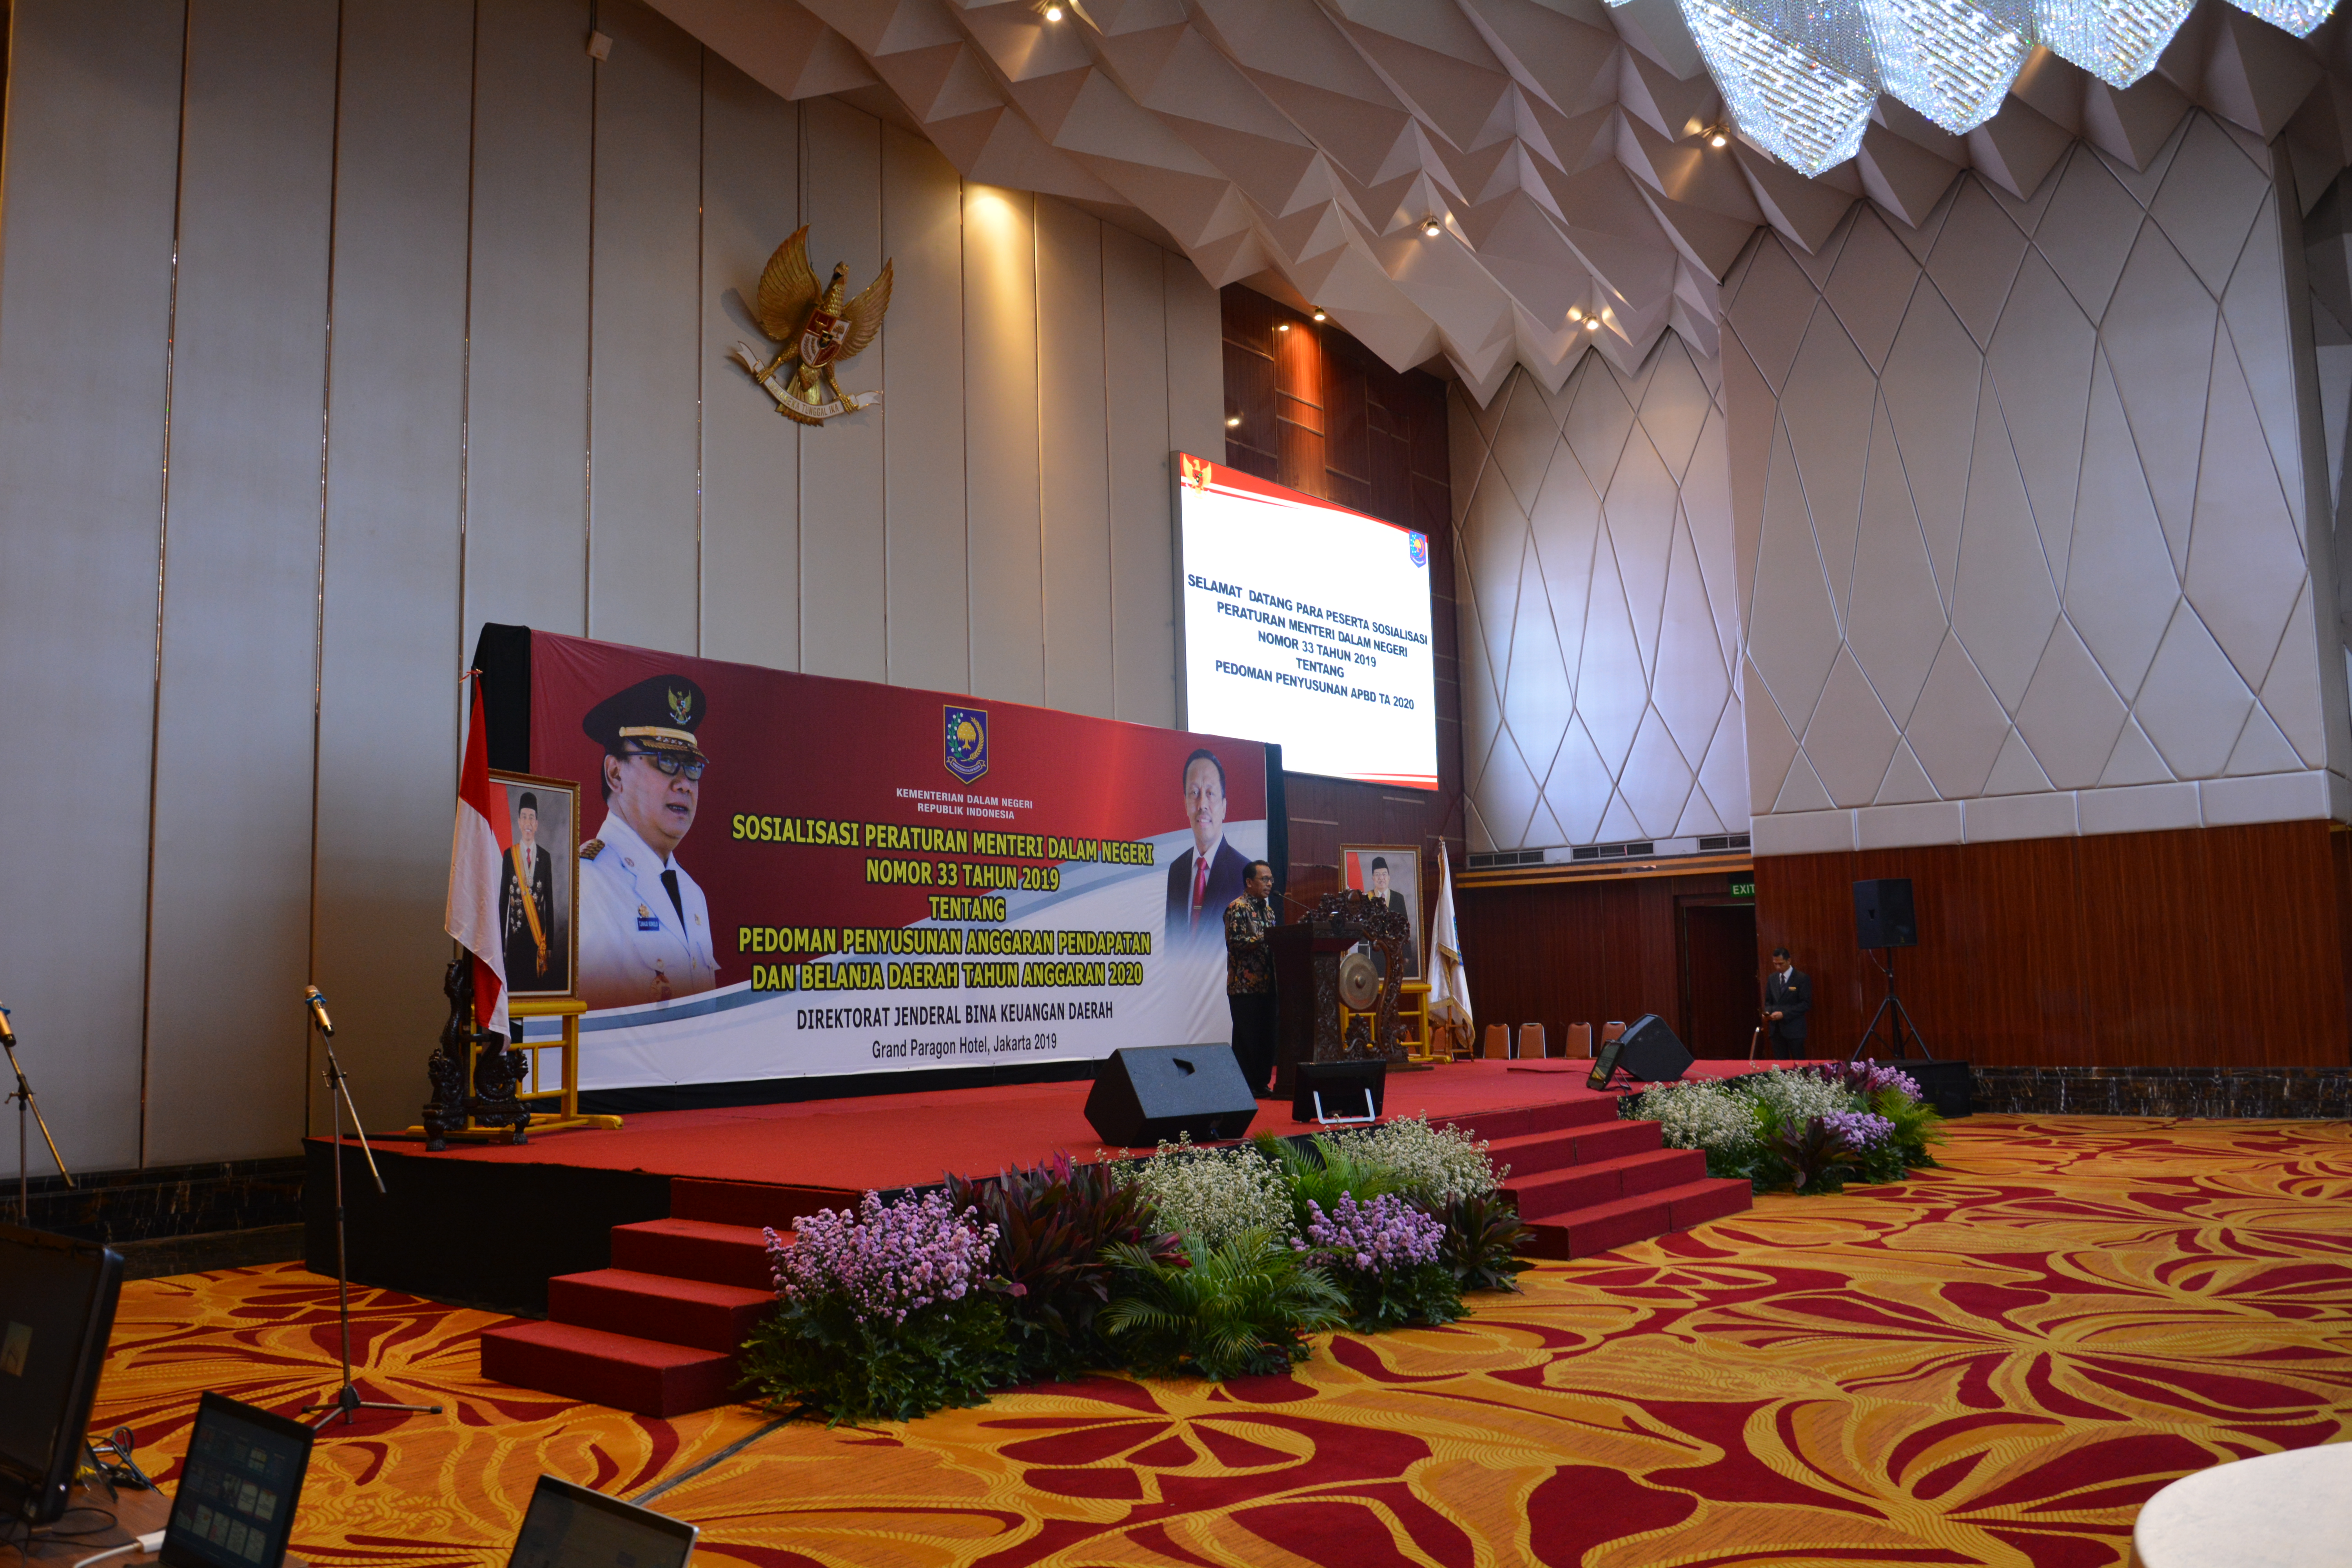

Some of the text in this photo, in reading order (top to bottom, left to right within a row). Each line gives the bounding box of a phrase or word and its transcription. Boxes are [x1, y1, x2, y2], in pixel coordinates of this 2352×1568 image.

[1188, 574, 1428, 645] SELAMAT DATANG PARA PESERTA SOSIALISASI
[1217, 601, 1408, 657] PERATURAN MENTERI DALAM NEGERI
[1258, 630, 1376, 668] NOMOR 33 TAHUN 2019
[1296, 657, 1344, 678] TENTANG
[1216, 660, 1414, 710] PEDOMAN PENYUSUNAN APBD TA 2020
[897, 788, 1033, 809] KEMENTERIAN DALAM NEGERI
[918, 803, 1014, 819] REPUBLIK INDONESIA
[732, 813, 1154, 865] SOSIALISASI PERATURAN MENTERI DALAM NEGERI
[866, 858, 1059, 891] NOMOR 33 TAHUN 2019
[1733, 884, 1755, 895] EXIT
[928, 896, 1005, 921] TENTANG
[739, 927, 1151, 954] PEDOMAN PENYUSUNAN ANGGARAN PENDAPATAN
[752, 963, 1143, 990] DAN BELANJA DAERAH TAHUN ANGGARAN 2020
[797, 1001, 1112, 1030] DIREKTORAT JENDERAL BINA KEUANGAN DAERAH
[872, 1033, 1056, 1059] Grand Paragon Hotel, Jakarta 2019
